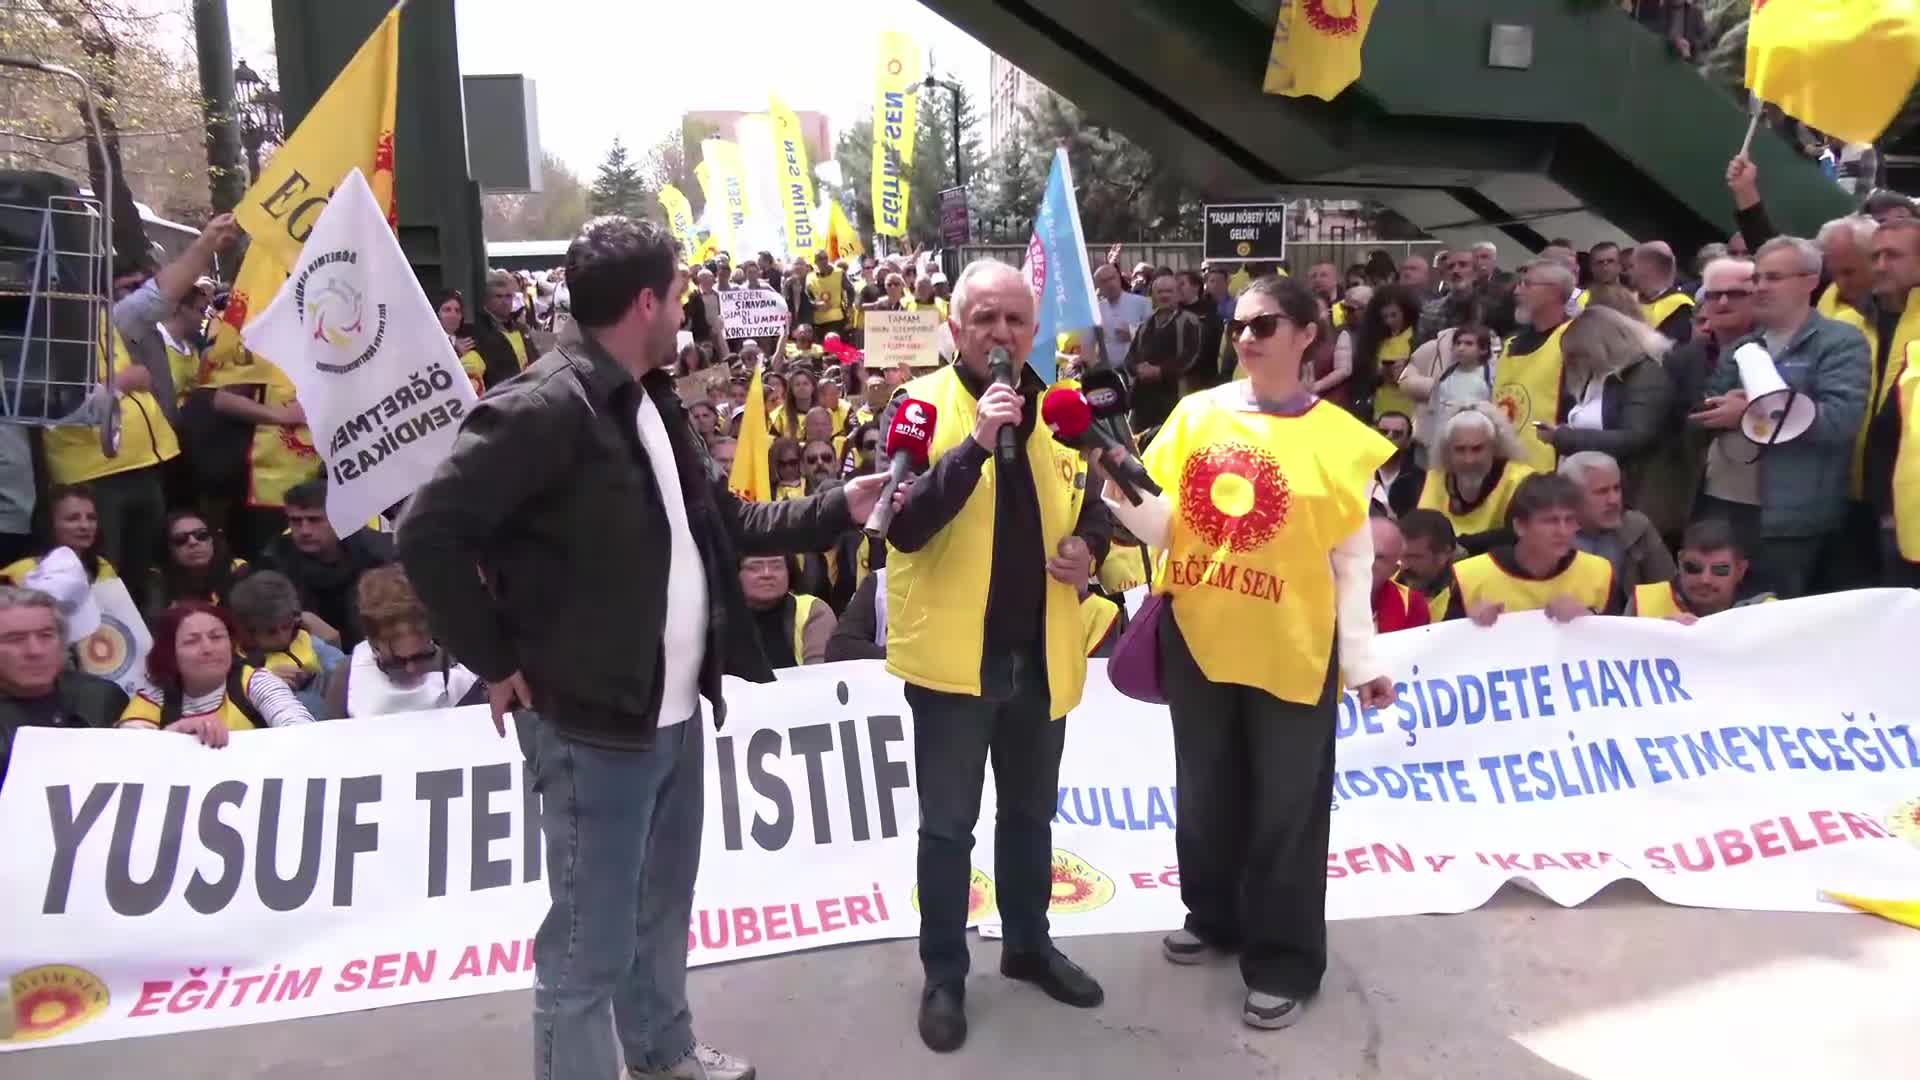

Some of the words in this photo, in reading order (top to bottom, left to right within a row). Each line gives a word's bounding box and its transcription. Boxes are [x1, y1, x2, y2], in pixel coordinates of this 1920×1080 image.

[896, 423, 925, 438] anka
[1240, 567, 1284, 603] SEN
[1393, 664, 1556, 747] ŞİDDETE
[1561, 658, 1693, 713] HAYIR
[42, 774, 382, 917] YUSUF
[715, 681, 910, 851] İSTİF
[1053, 786, 1178, 831] KULLA
[1478, 730, 1637, 804] TESLİM
[1635, 711, 1920, 784] ETMEYECEĞİZ
[1326, 842, 1415, 879] SEN
[128, 964, 322, 1017] EĞİTİM
[334, 949, 437, 993] SEN
